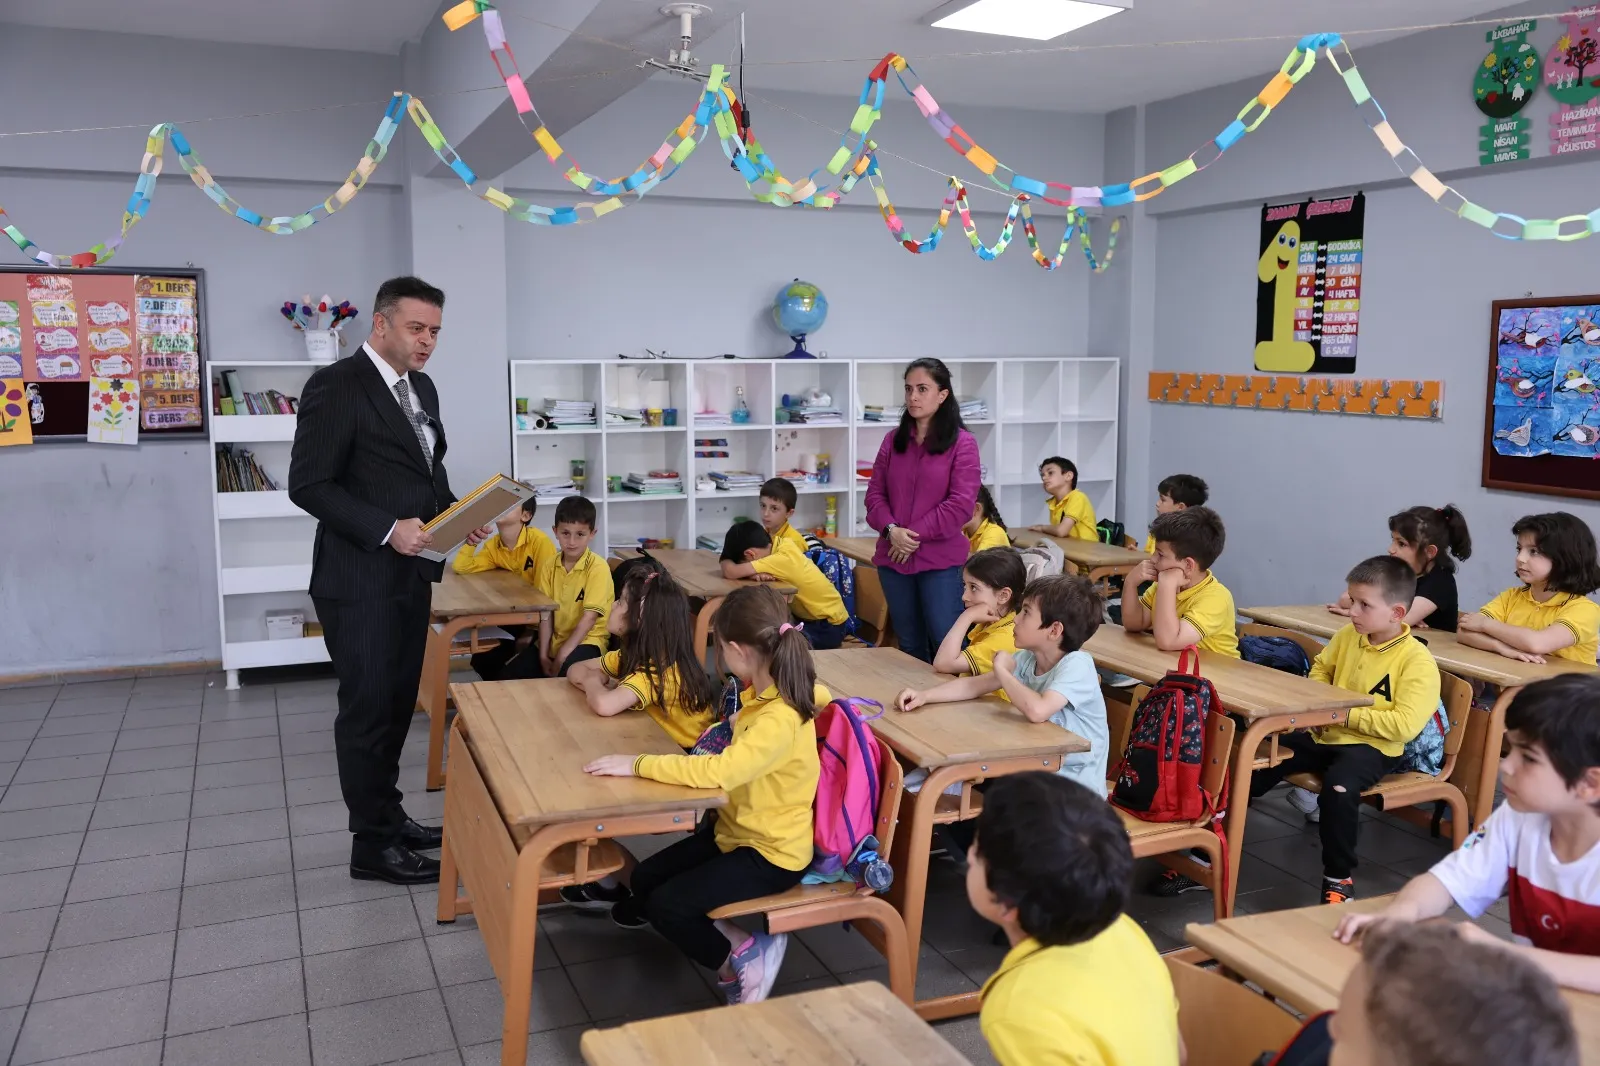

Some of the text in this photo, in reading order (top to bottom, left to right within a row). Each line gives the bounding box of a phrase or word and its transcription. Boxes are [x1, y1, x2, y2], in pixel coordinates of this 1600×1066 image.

[1491, 22, 1530, 41] İLKBAHAR
[1561, 106, 1600, 122] HAZİRAN
[1494, 121, 1518, 133] MART
[1557, 123, 1597, 138] TEMMUZ
[1493, 136, 1518, 148] NİSAN
[1557, 140, 1596, 154] AĞUSTOS
[1493, 151, 1518, 163] MAYIS
[1300, 242, 1316, 252] SAAT
[1327, 253, 1357, 264] 24 SAAT
[1331, 266, 1336, 276] 7
[1300, 276, 1310, 286] AY
[1341, 276, 1357, 288] GÜN
[165, 282, 190, 293] DERS
[1300, 287, 1310, 297] AY
[1328, 289, 1357, 299] 4 HAFTA
[1334, 312, 1357, 323] HAFTA
[1298, 320, 1308, 330] YIL
[1333, 345, 1350, 355] SAAT
[524, 556, 533, 571] A
[575, 588, 585, 602] A
[1368, 673, 1392, 702] A
